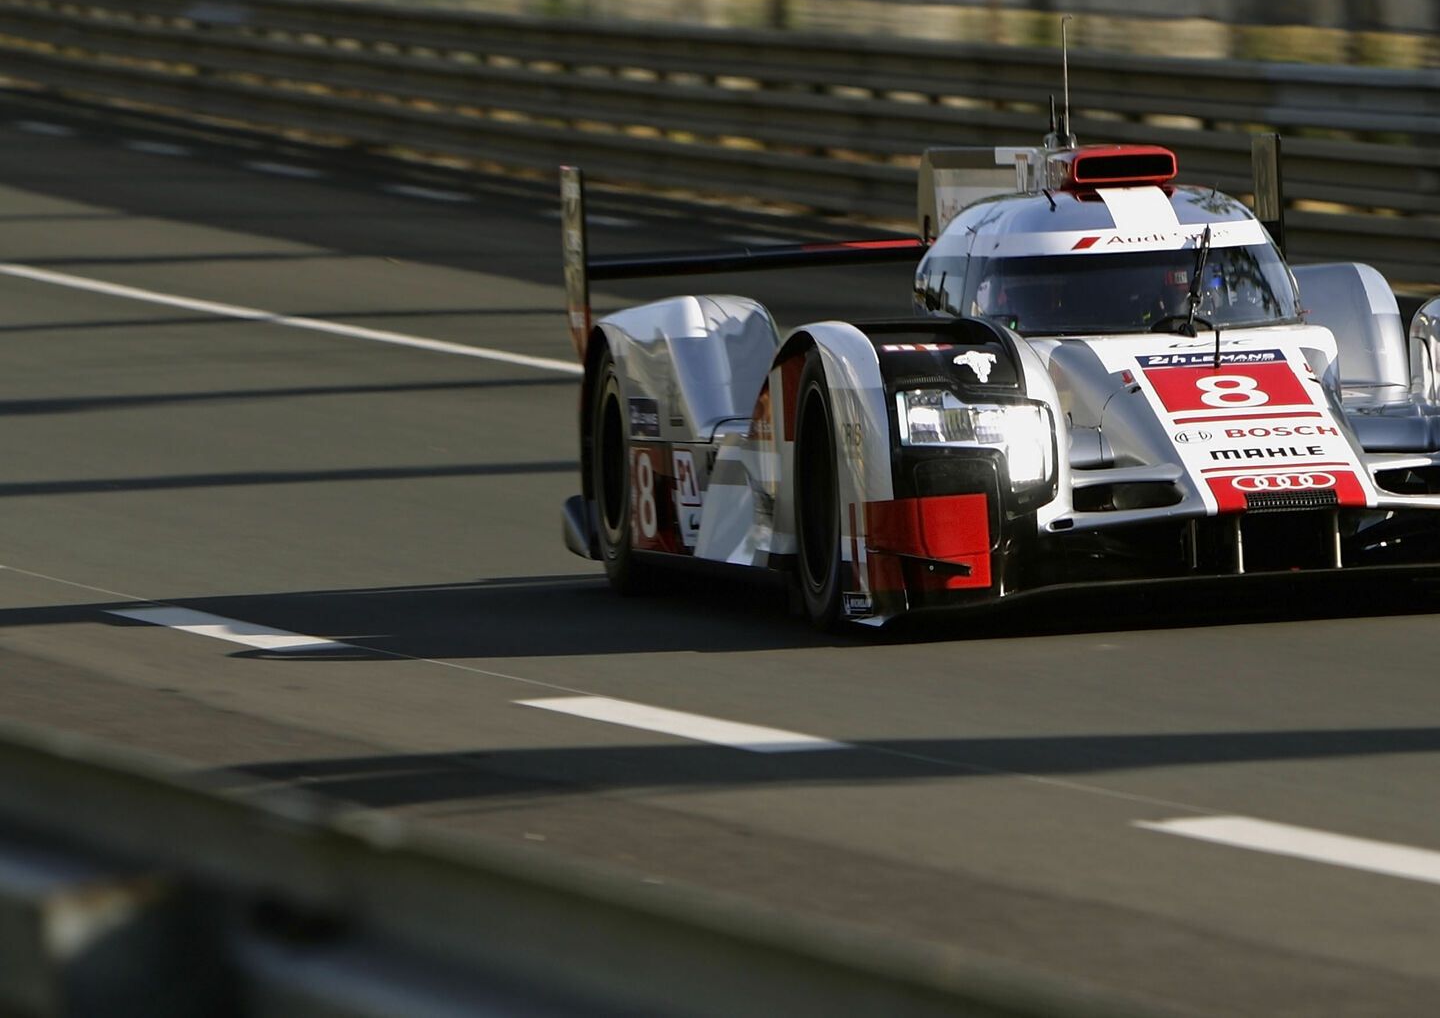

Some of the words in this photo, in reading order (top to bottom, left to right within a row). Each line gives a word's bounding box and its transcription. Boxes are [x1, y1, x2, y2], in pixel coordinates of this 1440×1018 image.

[1220, 353, 1275, 362] MANS
[1195, 374, 1270, 408] 8
[1225, 426, 1338, 438] BOSCH
[1210, 446, 1325, 460] MAHLE
[676, 459, 697, 497] P1
[637, 452, 657, 538] 8
